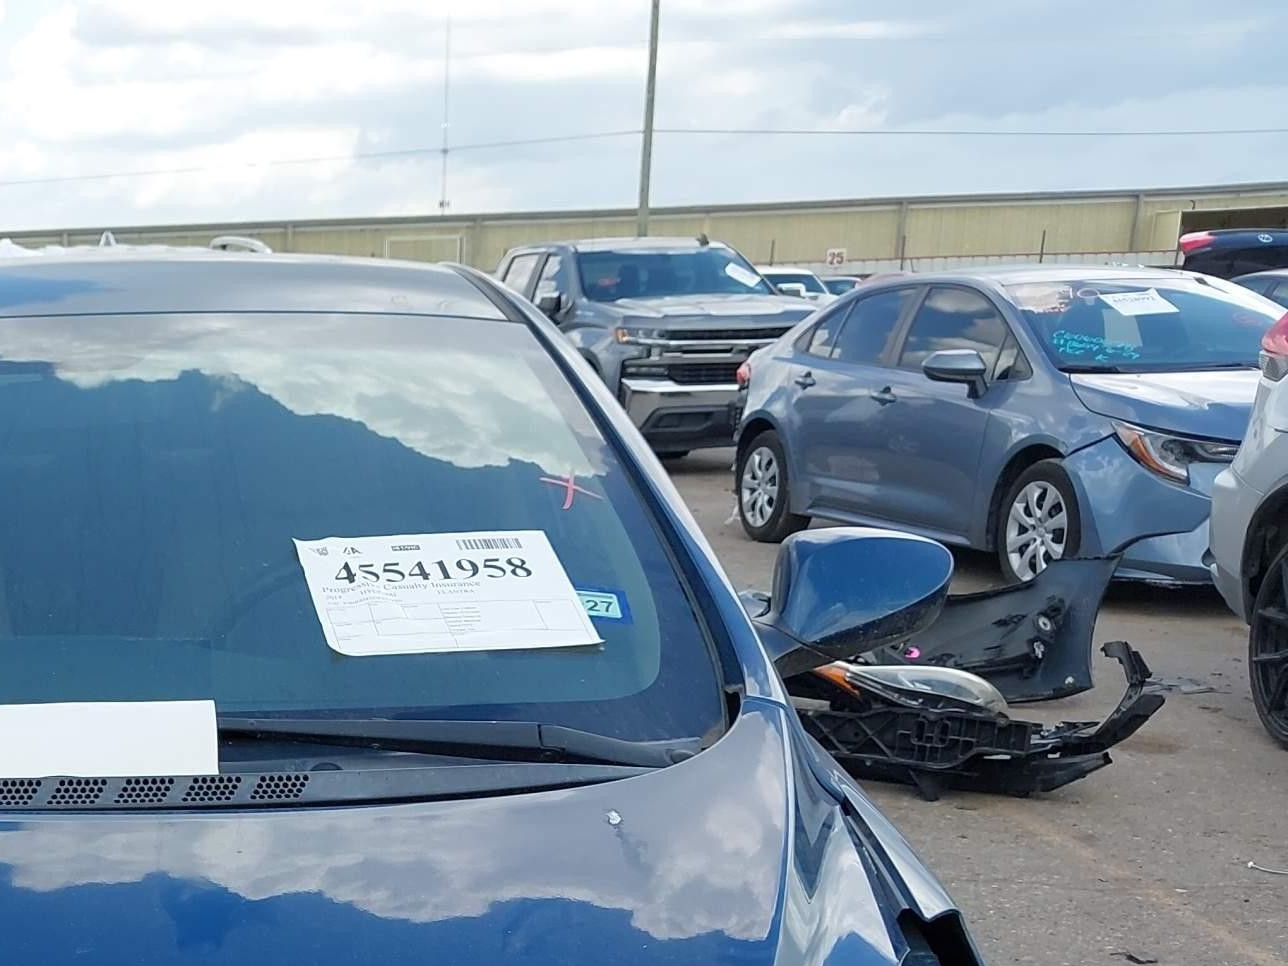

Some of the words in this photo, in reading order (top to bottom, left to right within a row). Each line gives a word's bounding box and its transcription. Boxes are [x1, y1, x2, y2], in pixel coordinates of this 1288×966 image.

[828, 251, 844, 265] 25
[335, 556, 532, 585] 45541958
[430, 580, 481, 589] Insurance
[585, 599, 613, 612] 27
